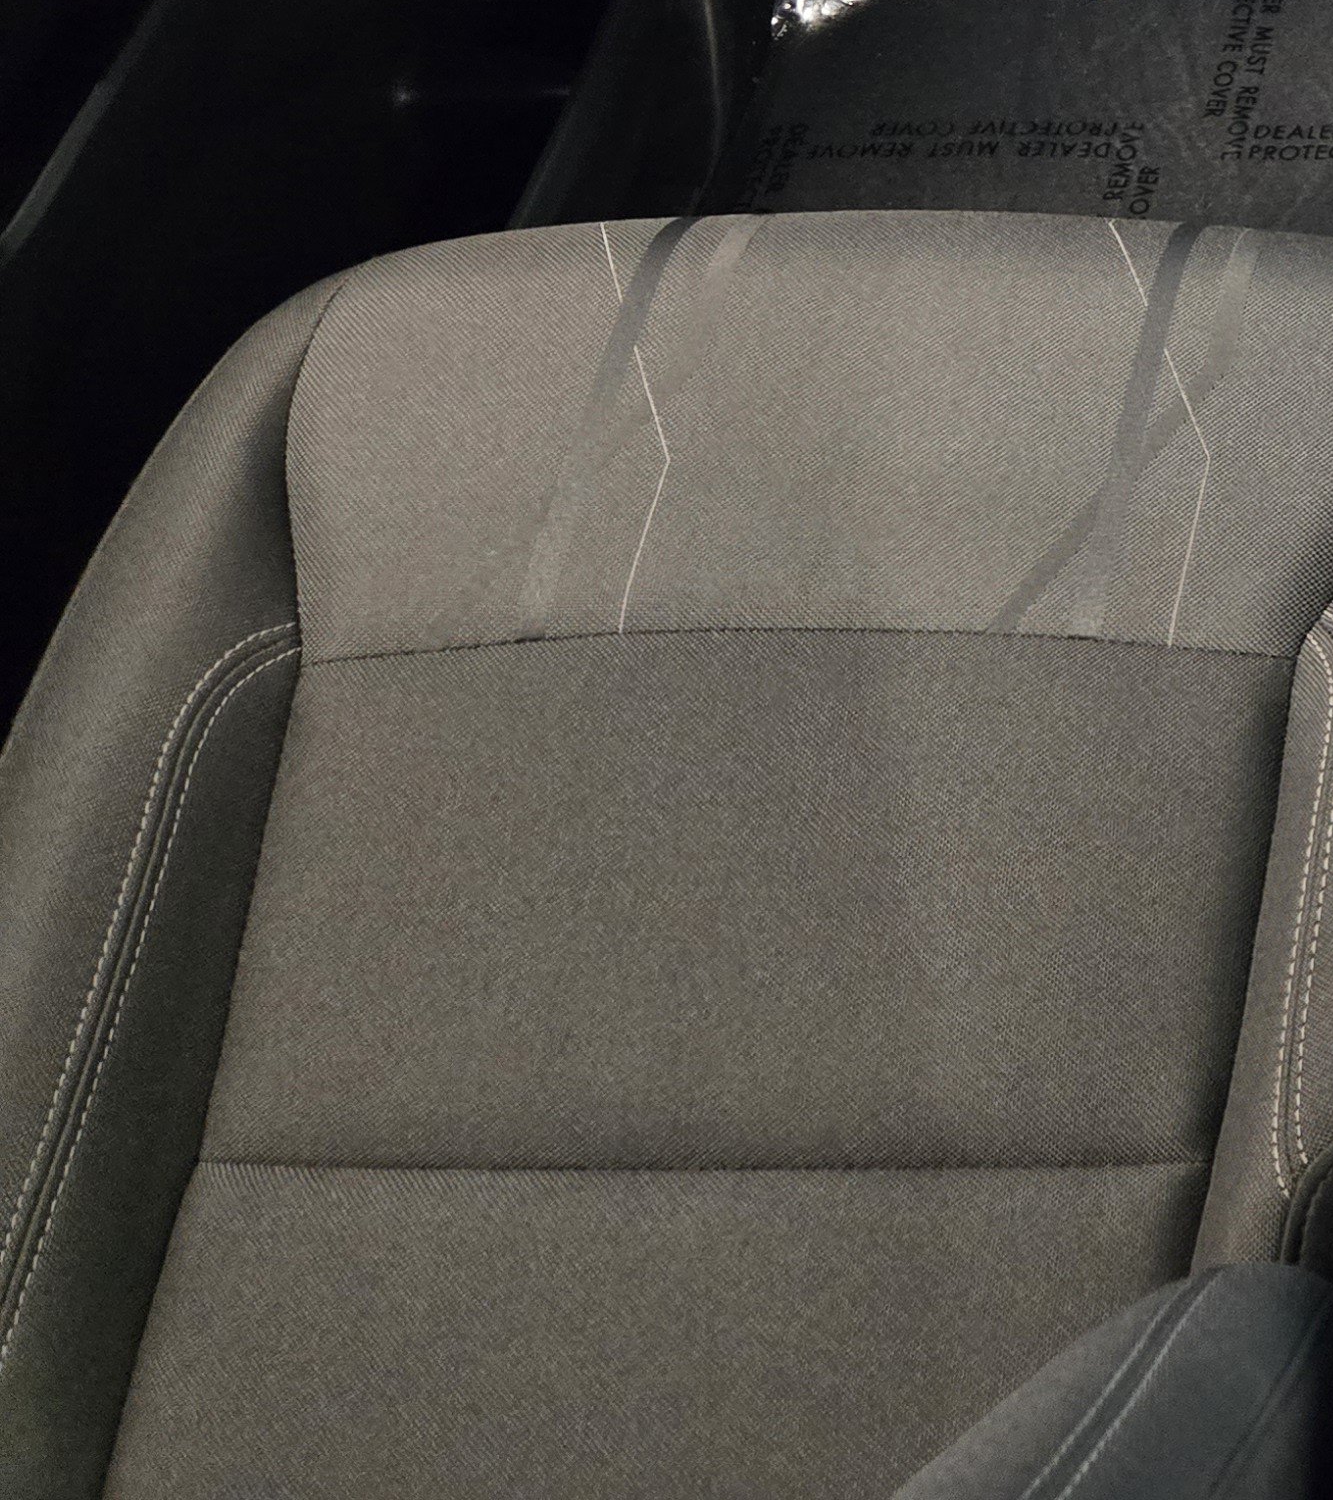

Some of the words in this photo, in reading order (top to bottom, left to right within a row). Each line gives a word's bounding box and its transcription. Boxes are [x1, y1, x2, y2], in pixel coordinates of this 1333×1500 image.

[1246, 25, 1274, 76] MUST
[1203, 59, 1238, 119] COVER
[1220, 85, 1260, 162] REMOVE
[1101, 120, 1144, 202] REMOVE
[1129, 164, 1161, 219] OVER
